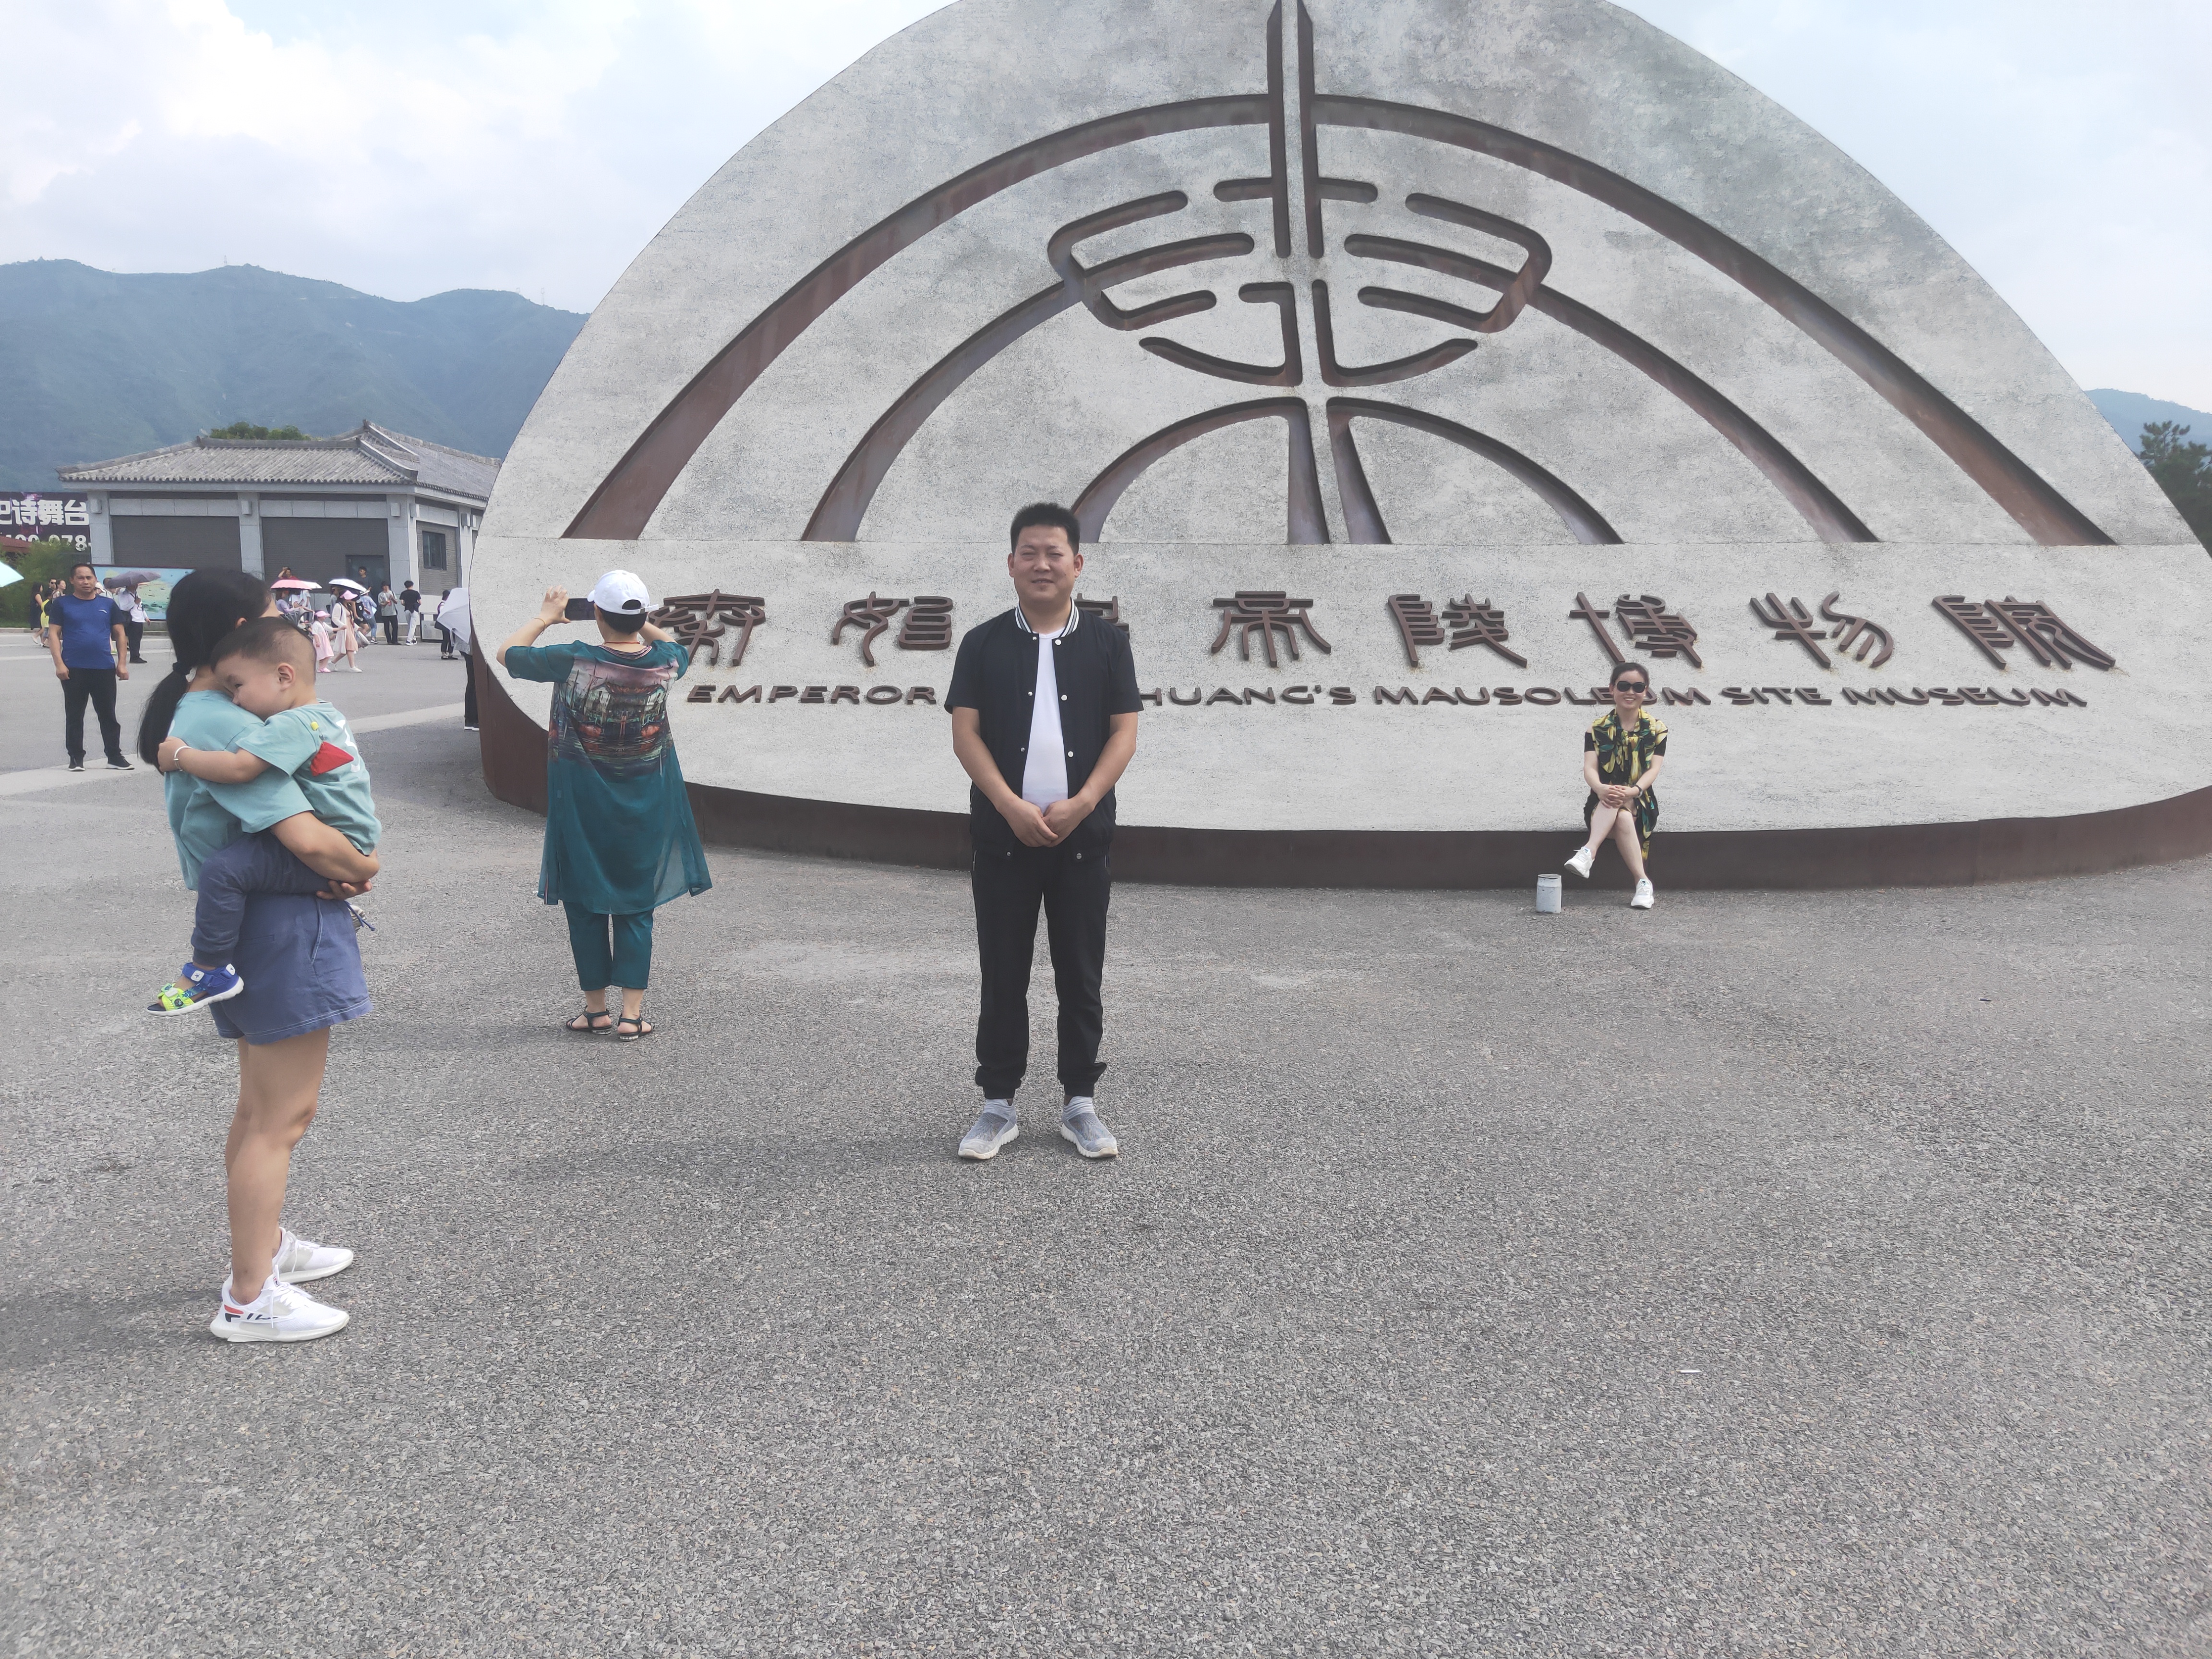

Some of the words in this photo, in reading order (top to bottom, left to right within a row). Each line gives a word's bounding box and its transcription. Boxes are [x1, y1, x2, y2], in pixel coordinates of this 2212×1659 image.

[649, 589, 2116, 670] 秦始帝陵博物院
[687, 685, 937, 705] EMPEROR
[1721, 686, 1832, 705] SITE
[1841, 686, 2087, 707] MUSEUM
